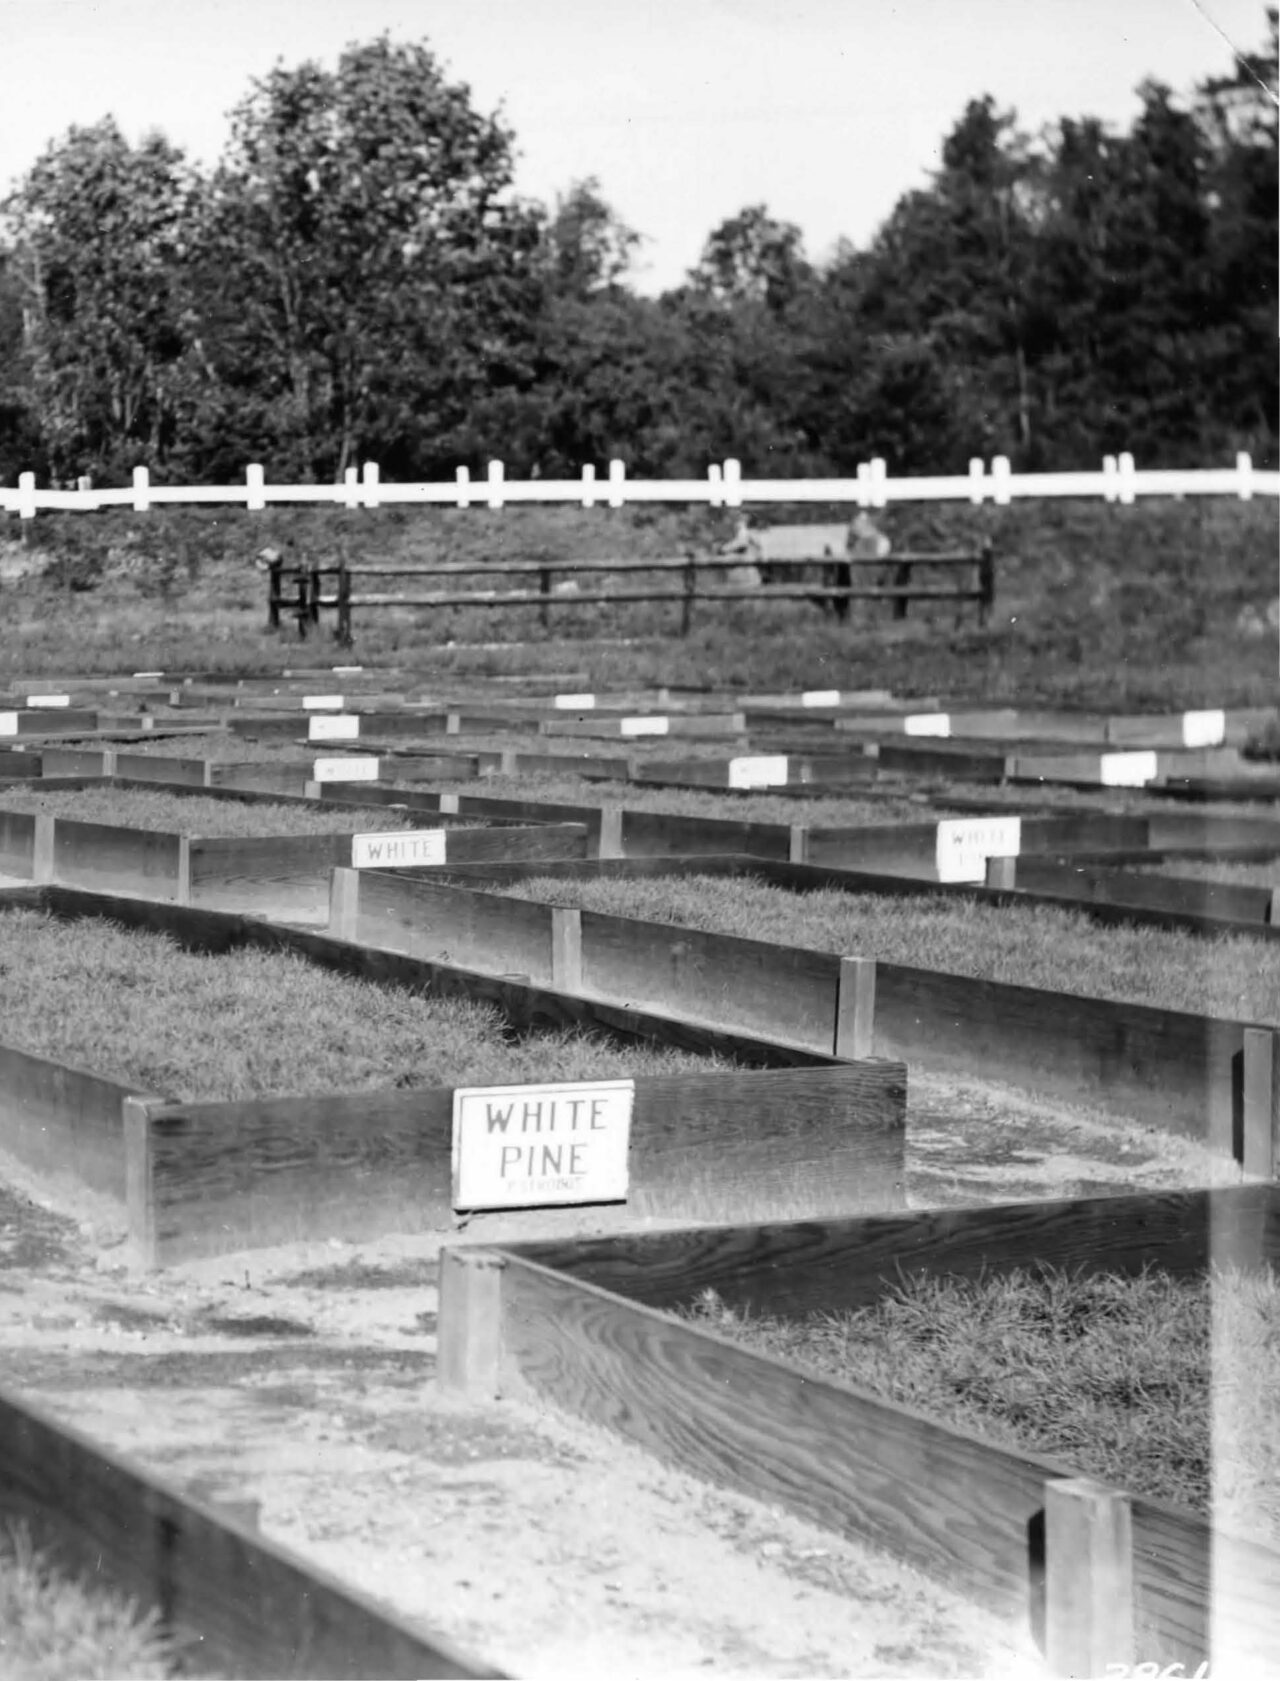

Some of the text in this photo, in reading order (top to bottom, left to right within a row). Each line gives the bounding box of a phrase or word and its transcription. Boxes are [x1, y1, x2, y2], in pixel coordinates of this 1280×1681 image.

[367, 840, 432, 860] WHITE
[485, 1098, 610, 1135] WHITE
[499, 1142, 589, 1179] PINE
